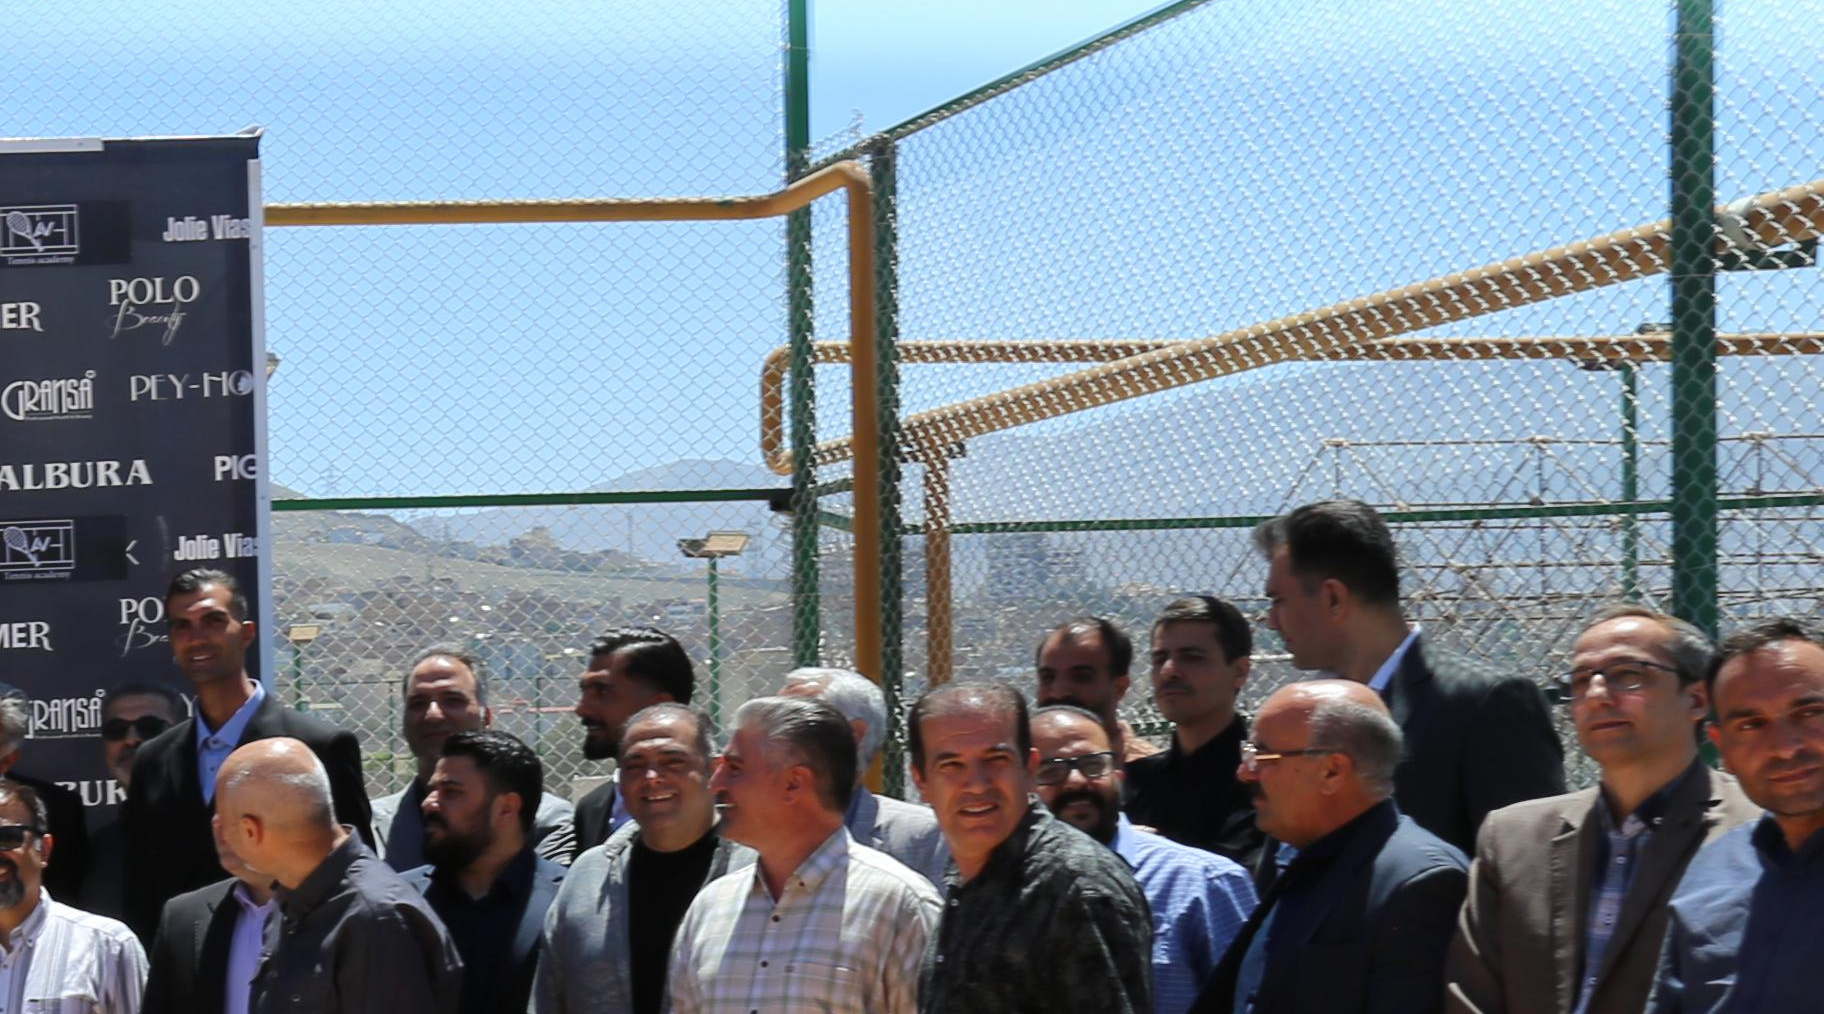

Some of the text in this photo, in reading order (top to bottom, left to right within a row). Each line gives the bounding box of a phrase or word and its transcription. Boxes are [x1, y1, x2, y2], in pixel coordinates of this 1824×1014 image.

[162, 215, 250, 242] Jolie Vias
[109, 275, 200, 307] POLO
[214, 454, 258, 481] PIG
[173, 534, 220, 561] Jolie
[119, 597, 165, 625] PO
